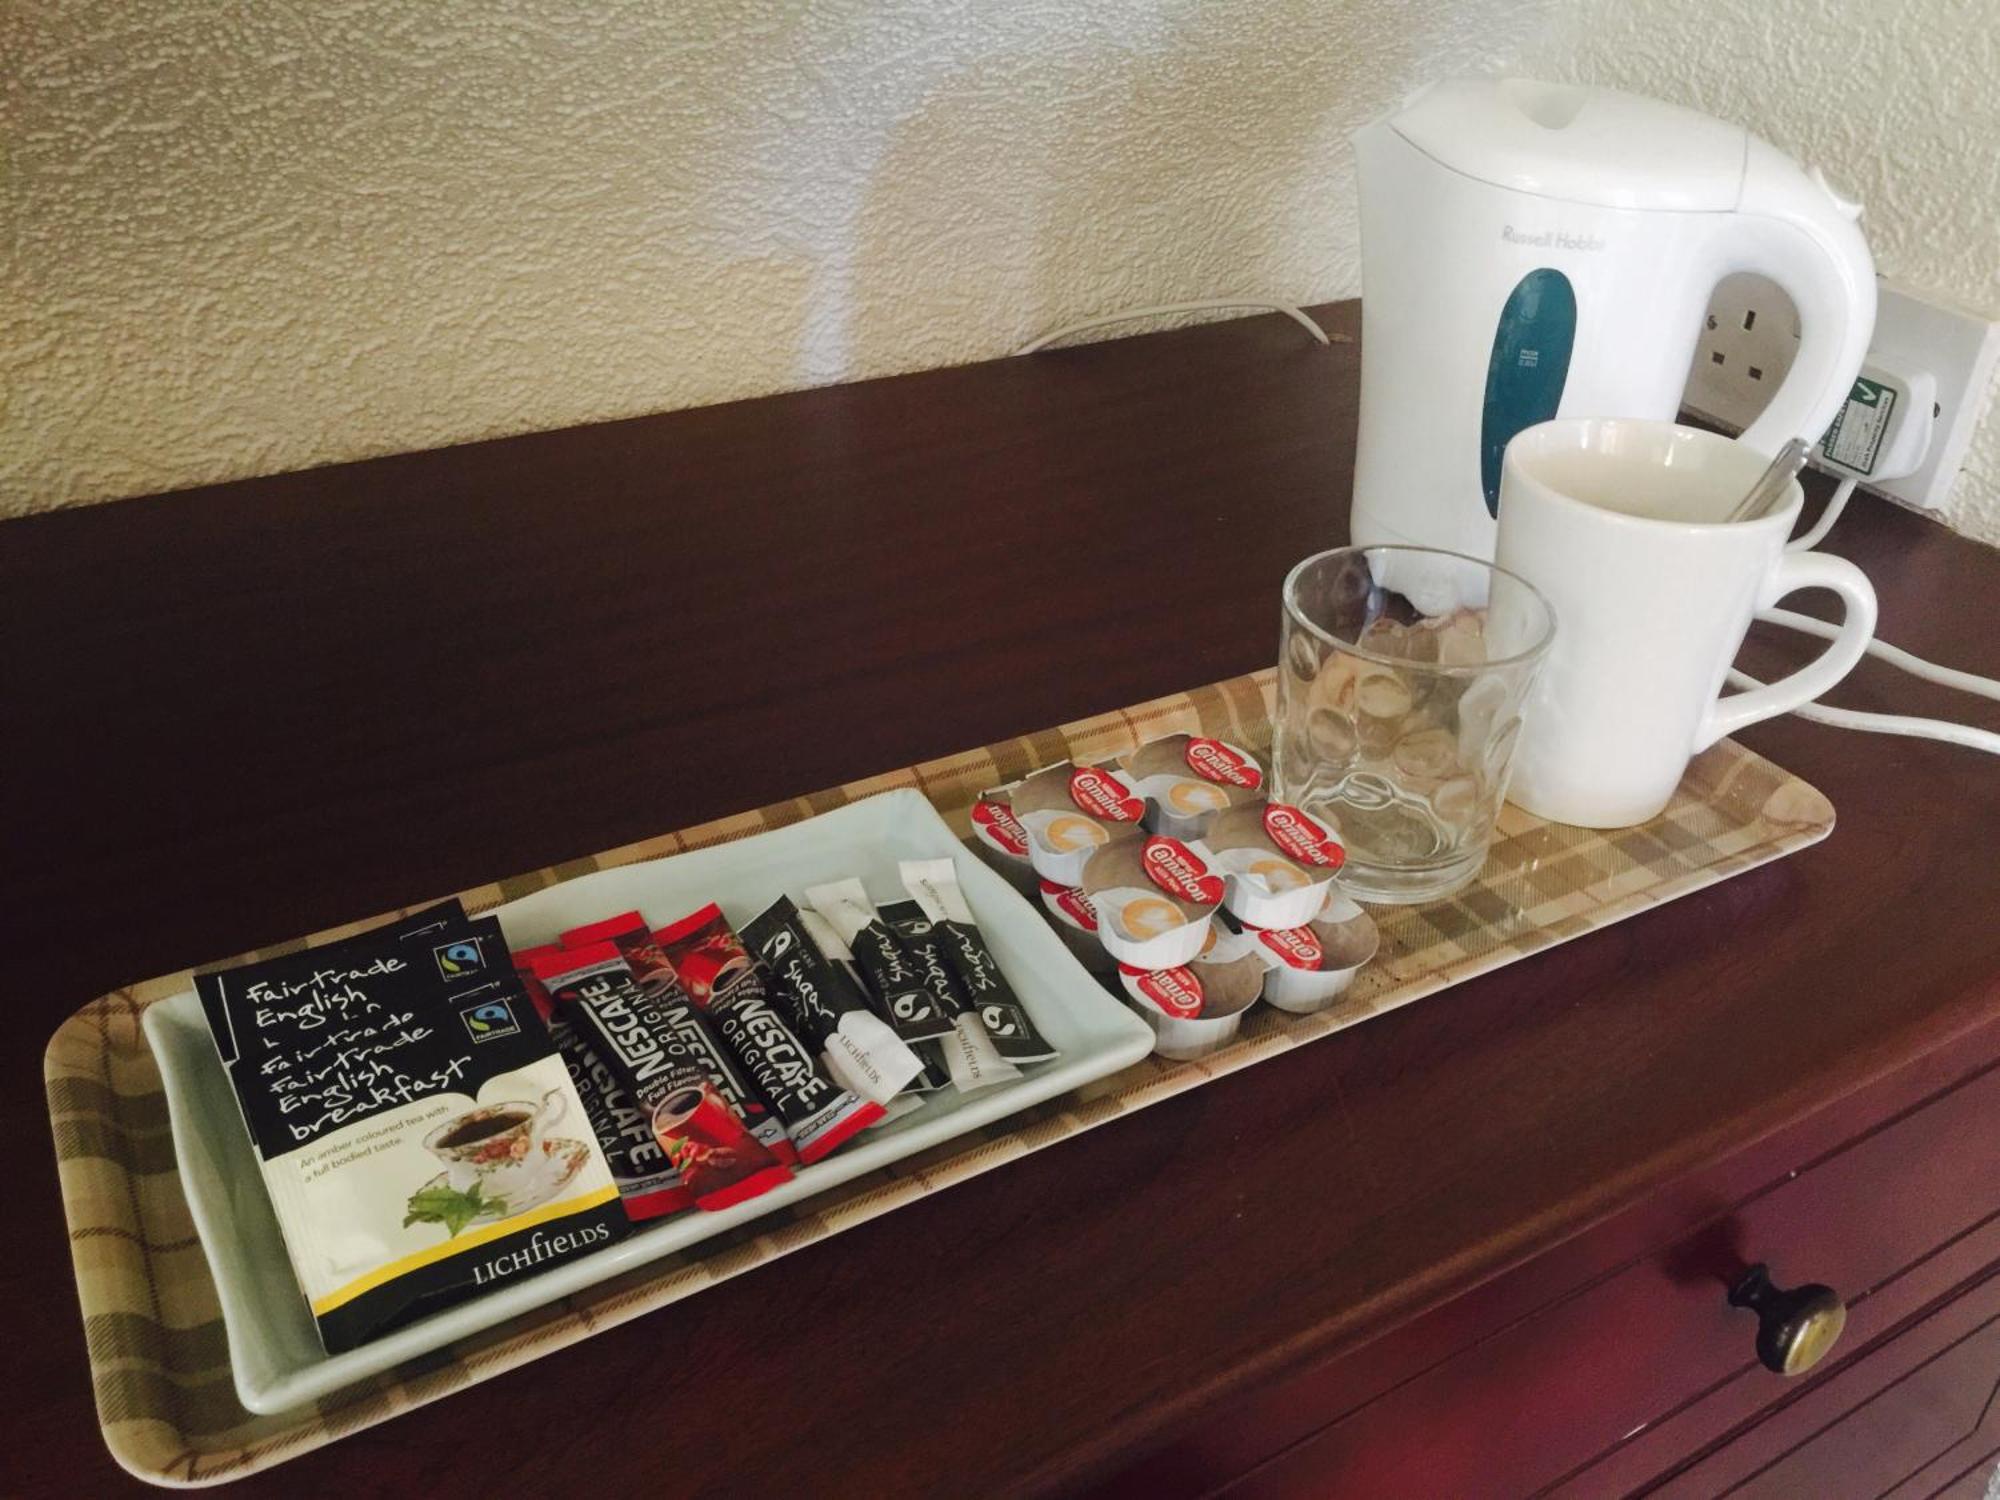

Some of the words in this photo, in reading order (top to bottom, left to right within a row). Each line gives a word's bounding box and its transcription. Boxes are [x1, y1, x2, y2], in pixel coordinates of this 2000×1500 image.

[1147, 844, 1207, 902] Carnation
[247, 958, 407, 1003] Fairtrade
[256, 984, 367, 1030] English
[617, 977, 687, 1056] ORIGINAL
[270, 1028, 434, 1093] Fairtrade
[279, 1060, 394, 1114] English
[722, 1019, 794, 1113] ORIGINAL
[289, 1056, 471, 1140] breakfast
[355, 1121, 404, 1145] coloured
[405, 1114, 424, 1128] tea
[424, 1105, 450, 1120] with
[313, 1164, 330, 1178] full
[331, 1147, 372, 1169] bodied
